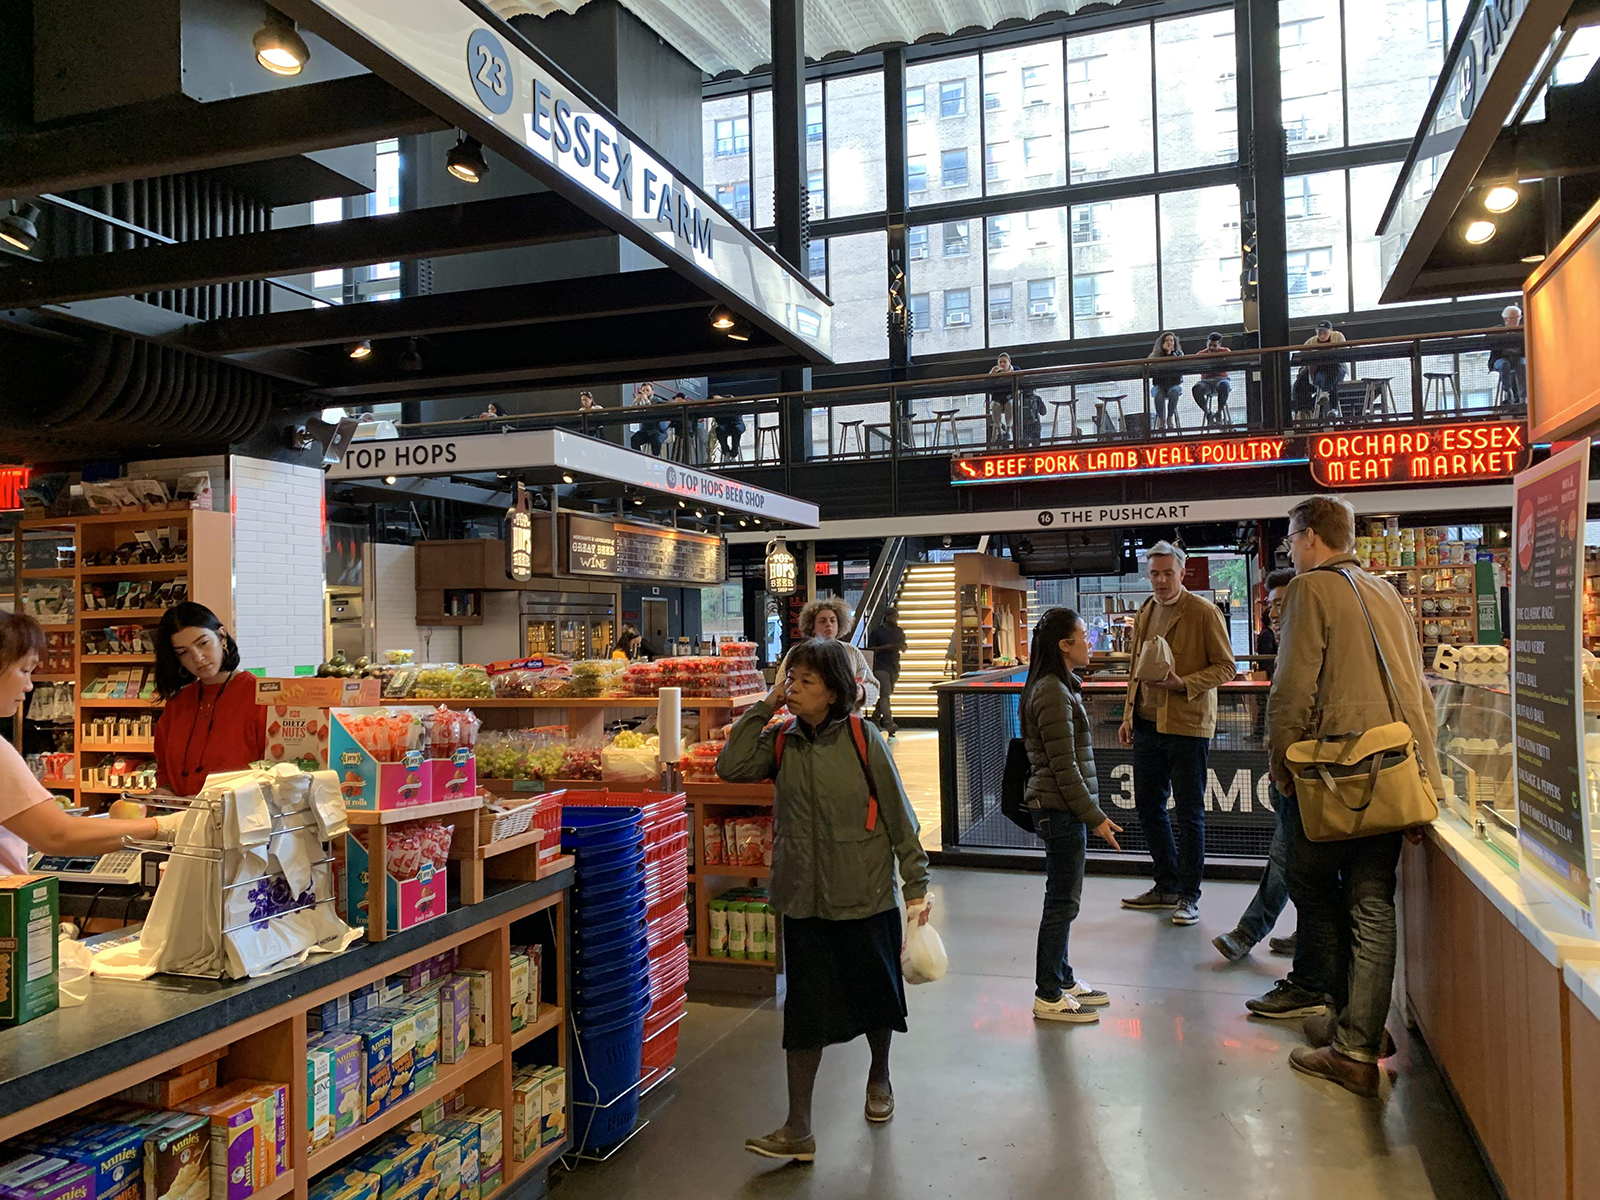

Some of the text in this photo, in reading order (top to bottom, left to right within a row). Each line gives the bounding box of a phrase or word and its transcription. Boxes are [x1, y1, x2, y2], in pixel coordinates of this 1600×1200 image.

[476, 45, 714, 260] 23 ESSEX FARM
[1318, 426, 1521, 458] ORCHARD ESSEX
[346, 443, 457, 469] TOP HOPS
[984, 440, 1284, 477] BEEF PORK LAMB VEAL POULTRY
[1328, 451, 1517, 481] MEAT MARKET
[679, 472, 699, 491] TOP
[700, 478, 724, 499] HOPS
[725, 485, 744, 503] BEER
[745, 490, 765, 509] SHOP
[1040, 505, 1190, 524] 16 THE PUSHCART
[572, 542, 616, 556] GREAT BEER
[773, 553, 791, 563] TOP
[579, 557, 608, 570] WINE
[769, 563, 795, 580] HOPS
[770, 578, 794, 587] BEER
[1524, 606, 1541, 620] CLASSIC
[1527, 673, 1538, 688] BALL
[1533, 708, 1545, 724] BALL
[281, 727, 306, 738] NUTS
[352, 798, 367, 806] rolls
[371, 1036, 391, 1055] Annie's
[336, 1049, 360, 1067] Annie's
[172, 1132, 200, 1156] Annie's
[100, 1146, 137, 1175] Annie's
[244, 1150, 252, 1187] Annie's
